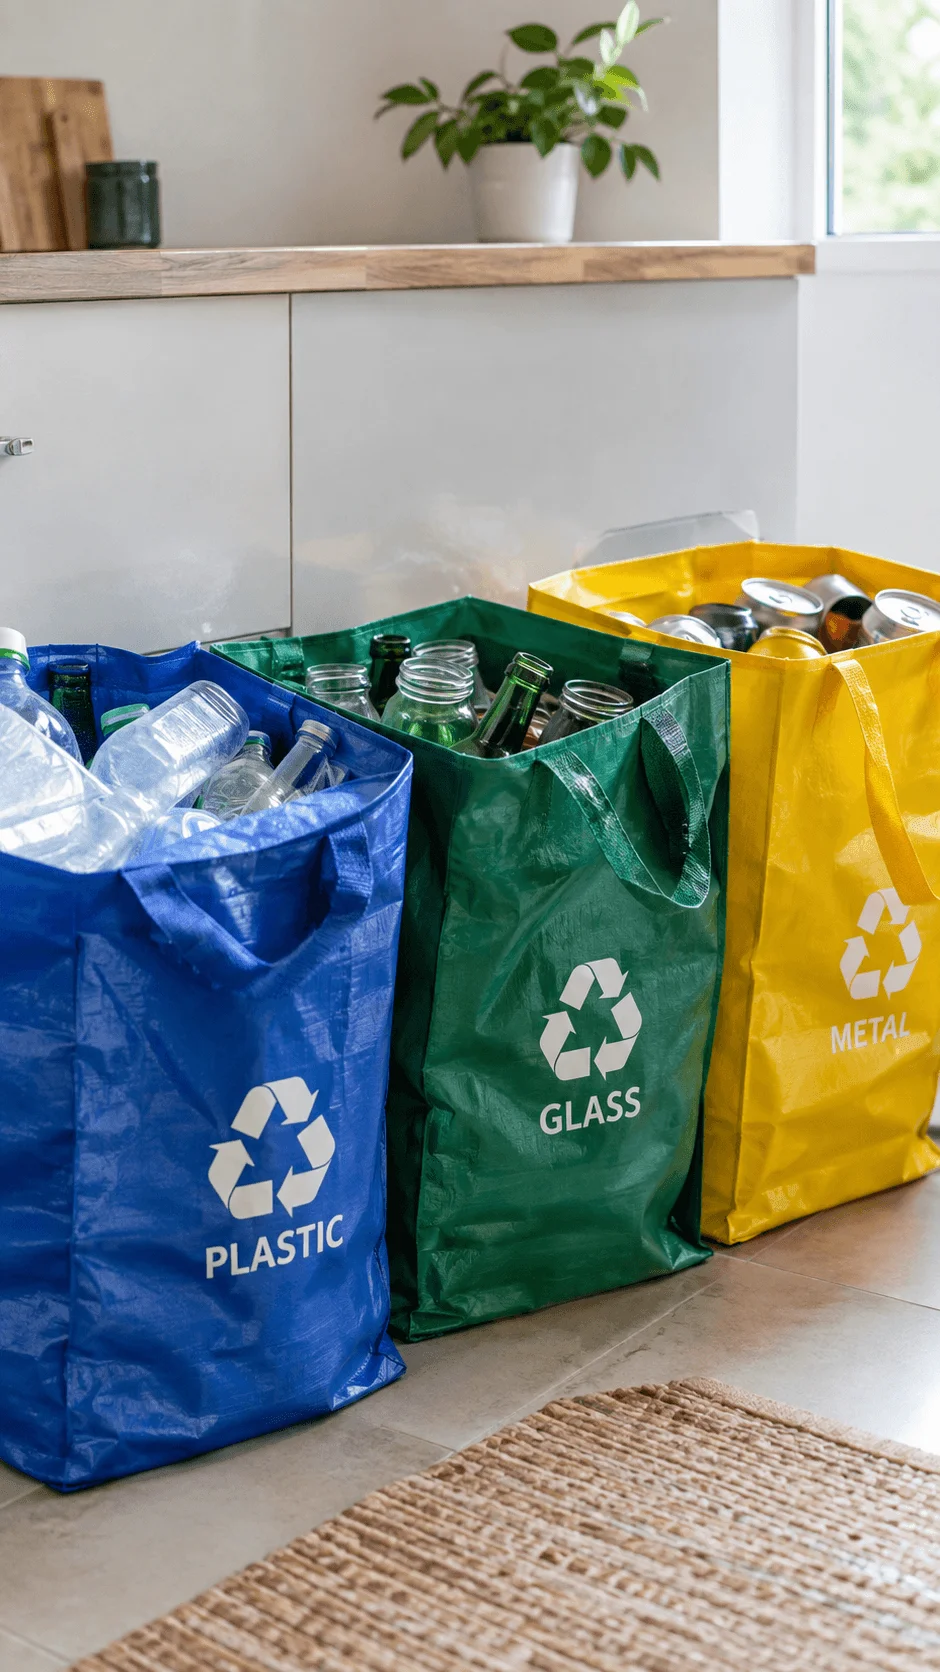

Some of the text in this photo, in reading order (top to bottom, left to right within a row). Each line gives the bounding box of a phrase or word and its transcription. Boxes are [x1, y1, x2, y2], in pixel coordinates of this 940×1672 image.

[831, 1011, 910, 1055] METAL
[539, 1086, 641, 1135] GLASS
[205, 1214, 344, 1279] PLASTIC
